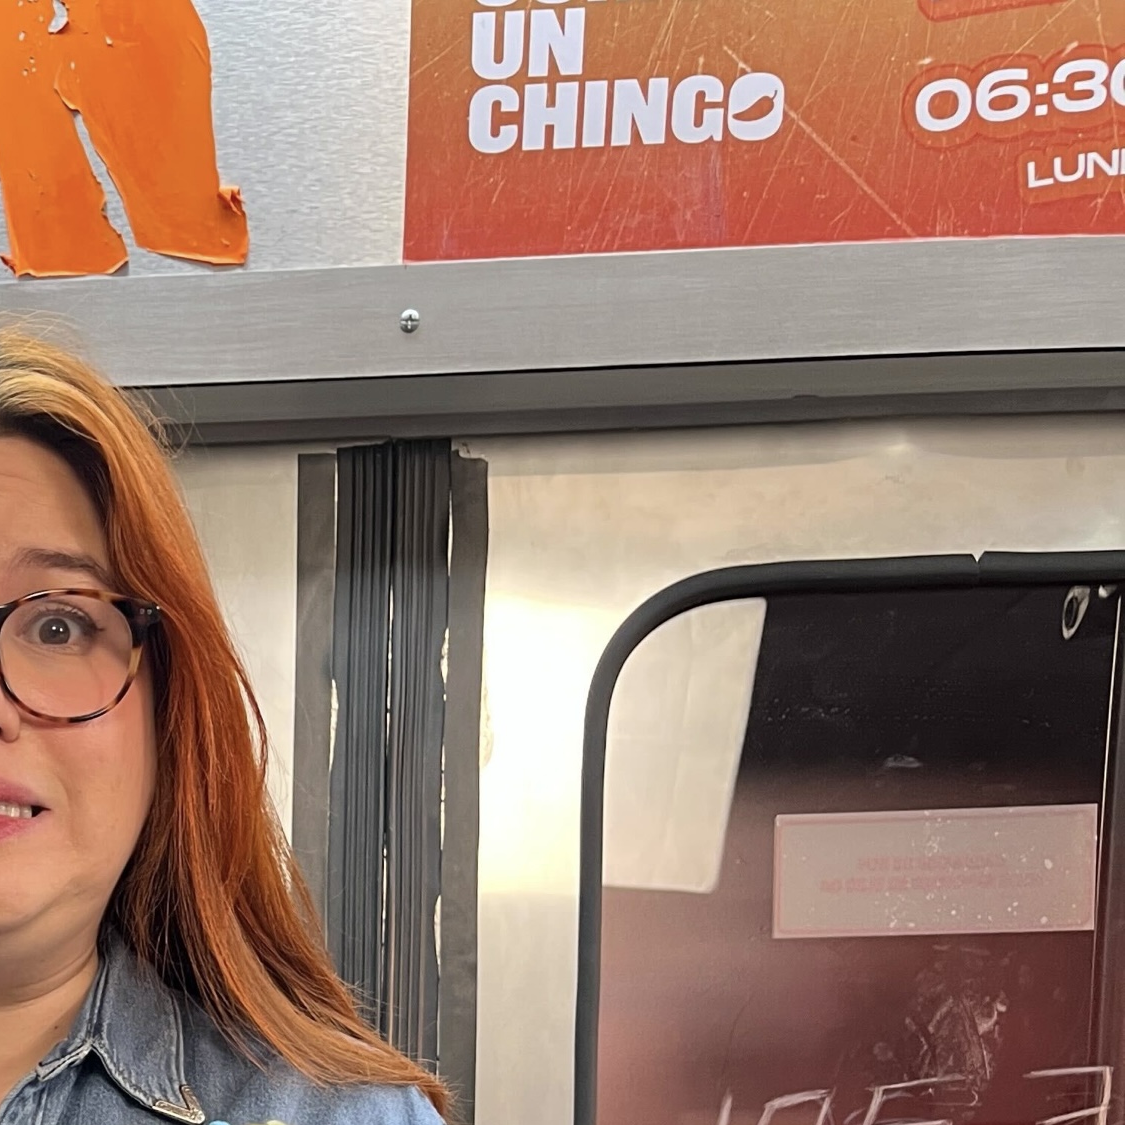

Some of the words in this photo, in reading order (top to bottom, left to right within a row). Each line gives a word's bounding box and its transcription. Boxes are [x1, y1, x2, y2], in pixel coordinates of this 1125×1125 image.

[471, 7, 585, 80] UN
[468, 72, 785, 154] CHINGO
[915, 57, 1125, 132] 06:3
[1027, 148, 1125, 188] LUN
